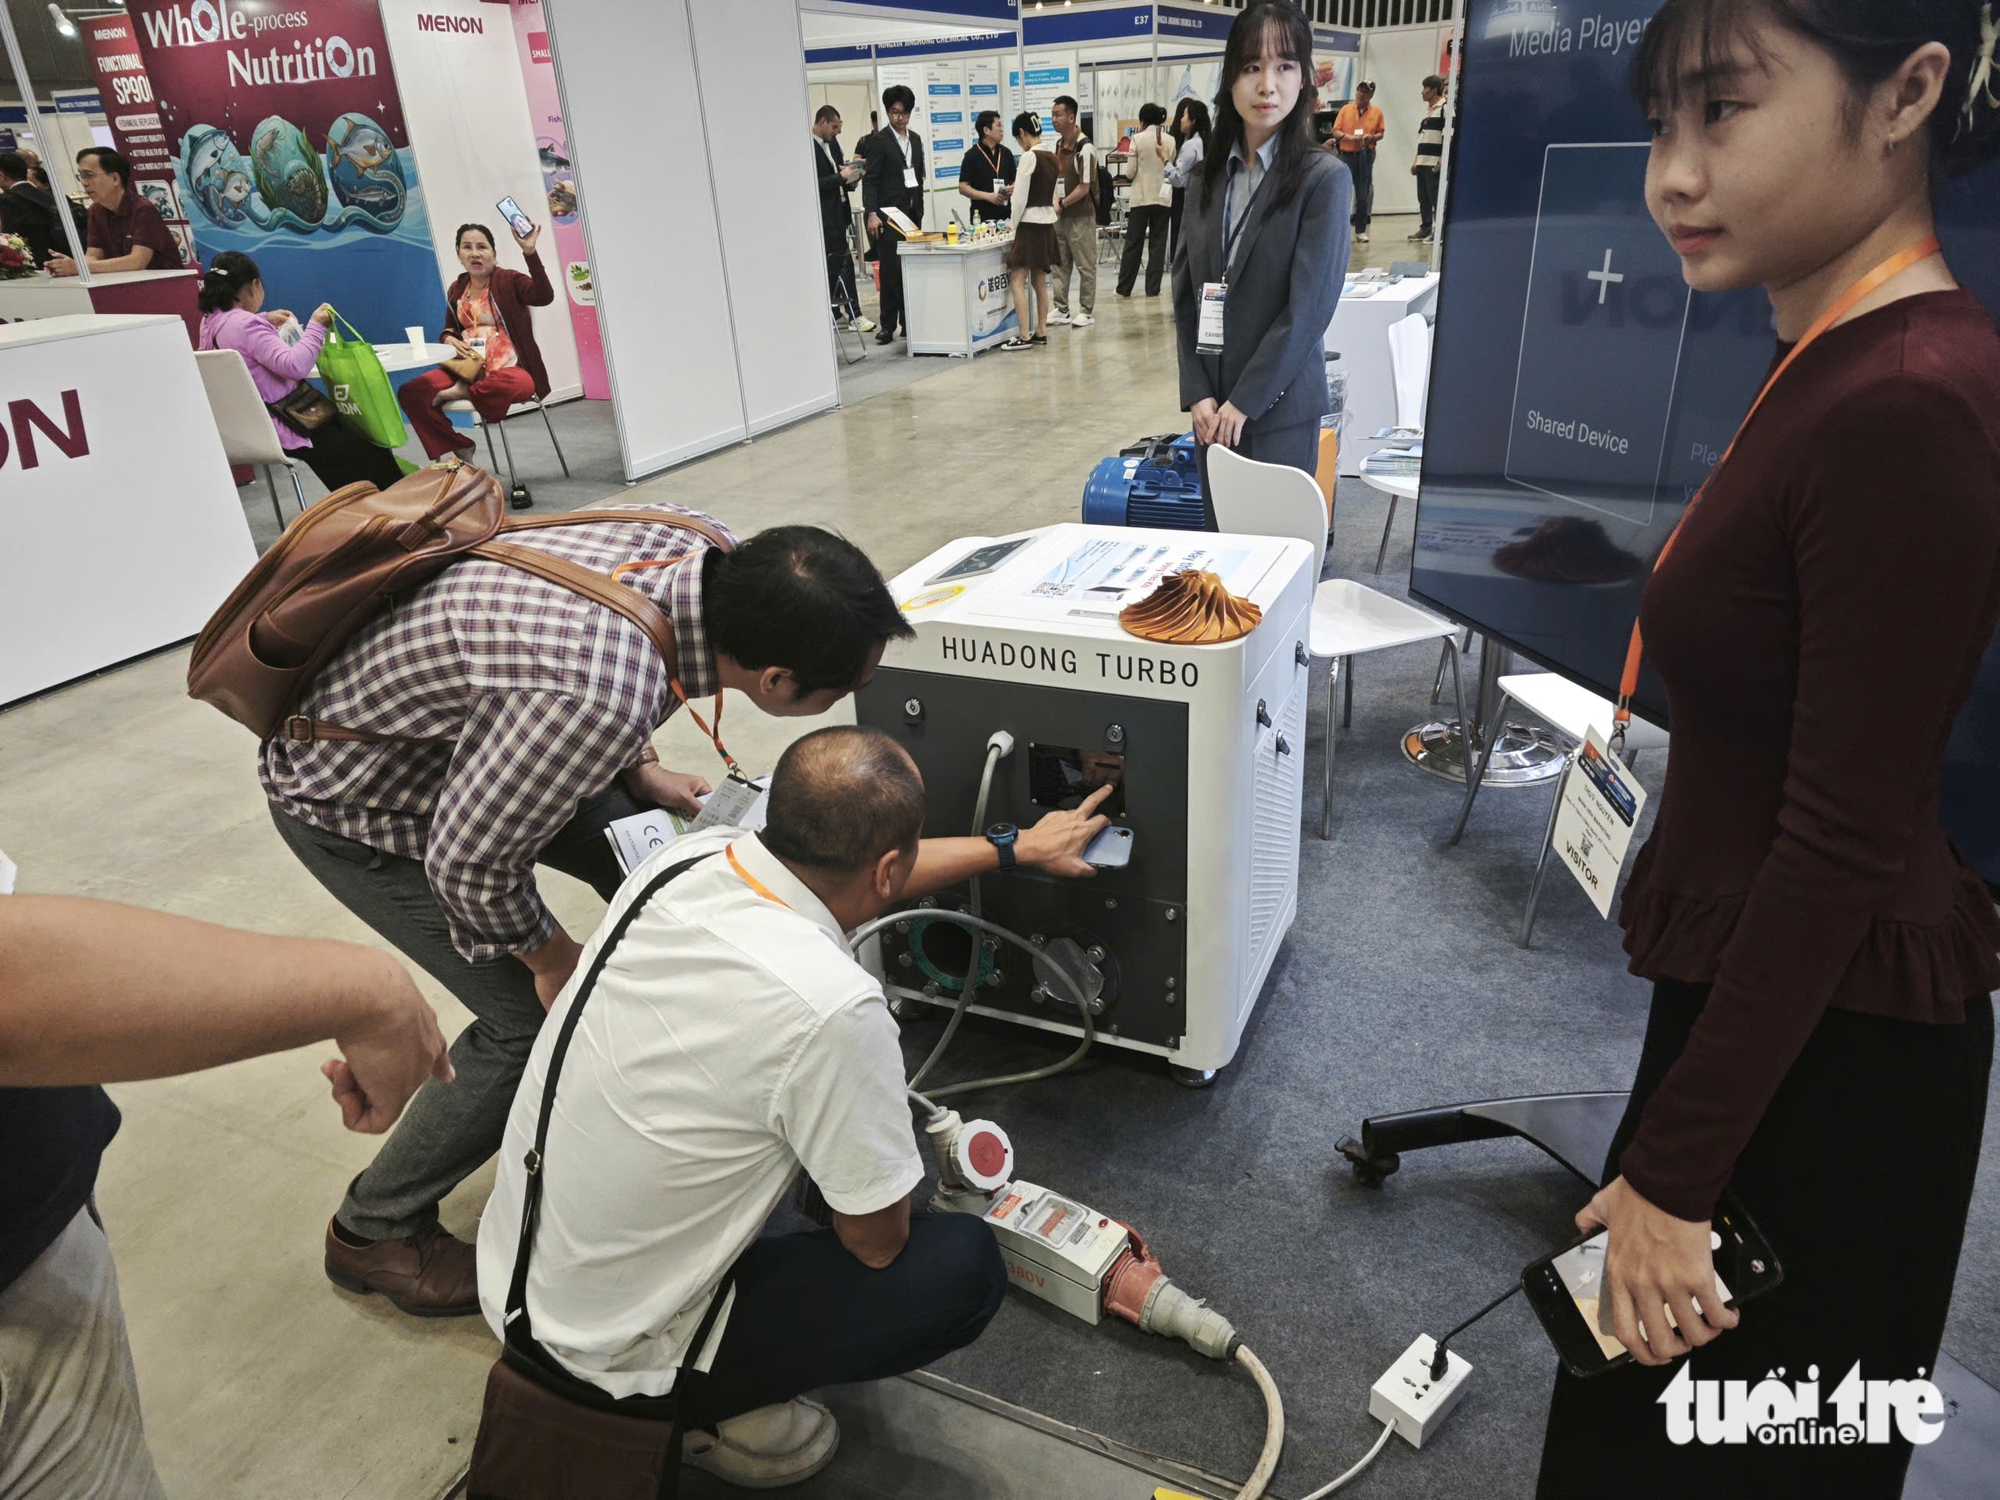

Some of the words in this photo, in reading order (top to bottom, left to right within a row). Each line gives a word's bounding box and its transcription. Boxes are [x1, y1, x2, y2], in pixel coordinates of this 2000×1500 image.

[94, 27, 127, 40] MENON
[417, 13, 483, 34] MENON
[1134, 16, 1149, 25] E37
[1509, 22, 1572, 58] Media
[1578, 15, 1652, 55] Player
[97, 53, 144, 72] FUNCTIONAL
[1527, 410, 1576, 440] Shared
[1578, 423, 1629, 454] Device
[941, 636, 1078, 675] HUADONG
[1095, 652, 1200, 688] TURBO
[1565, 840, 1599, 891] VISITOR
